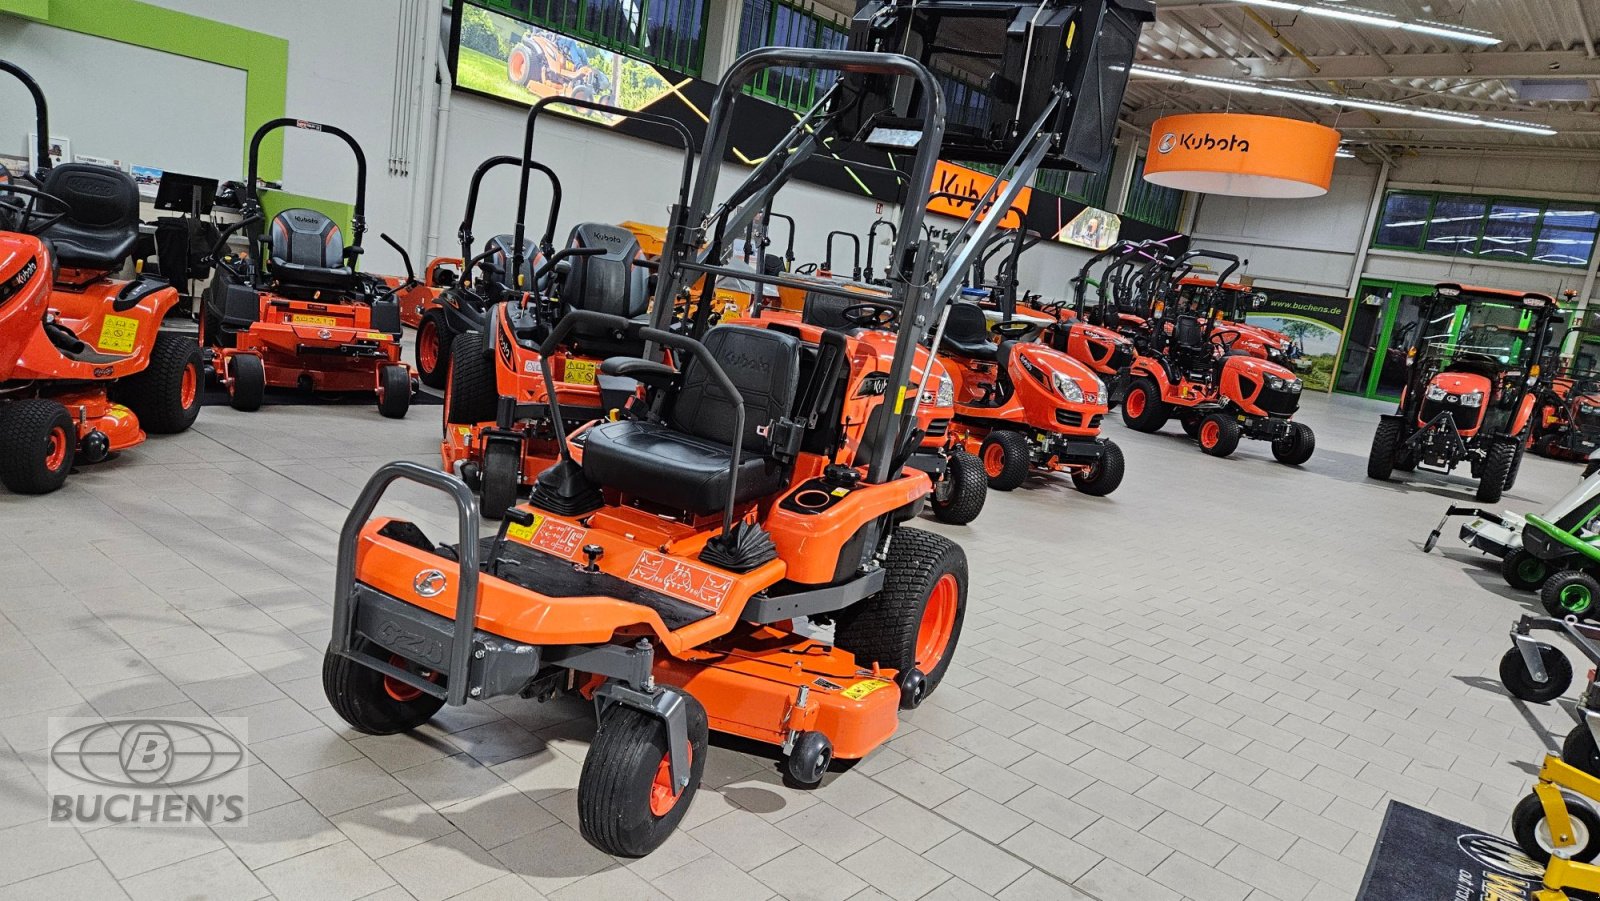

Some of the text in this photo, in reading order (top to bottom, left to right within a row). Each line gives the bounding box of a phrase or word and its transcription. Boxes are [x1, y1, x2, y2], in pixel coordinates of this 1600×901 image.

[1179, 132, 1250, 153] Kubota
[294, 215, 319, 225] Kubota
[593, 231, 621, 244] Kubota
[15, 262, 37, 285] Kubota
[1270, 299, 1342, 316] www.buchens.de
[724, 349, 770, 371] Kubota
[378, 620, 444, 665] GZD
